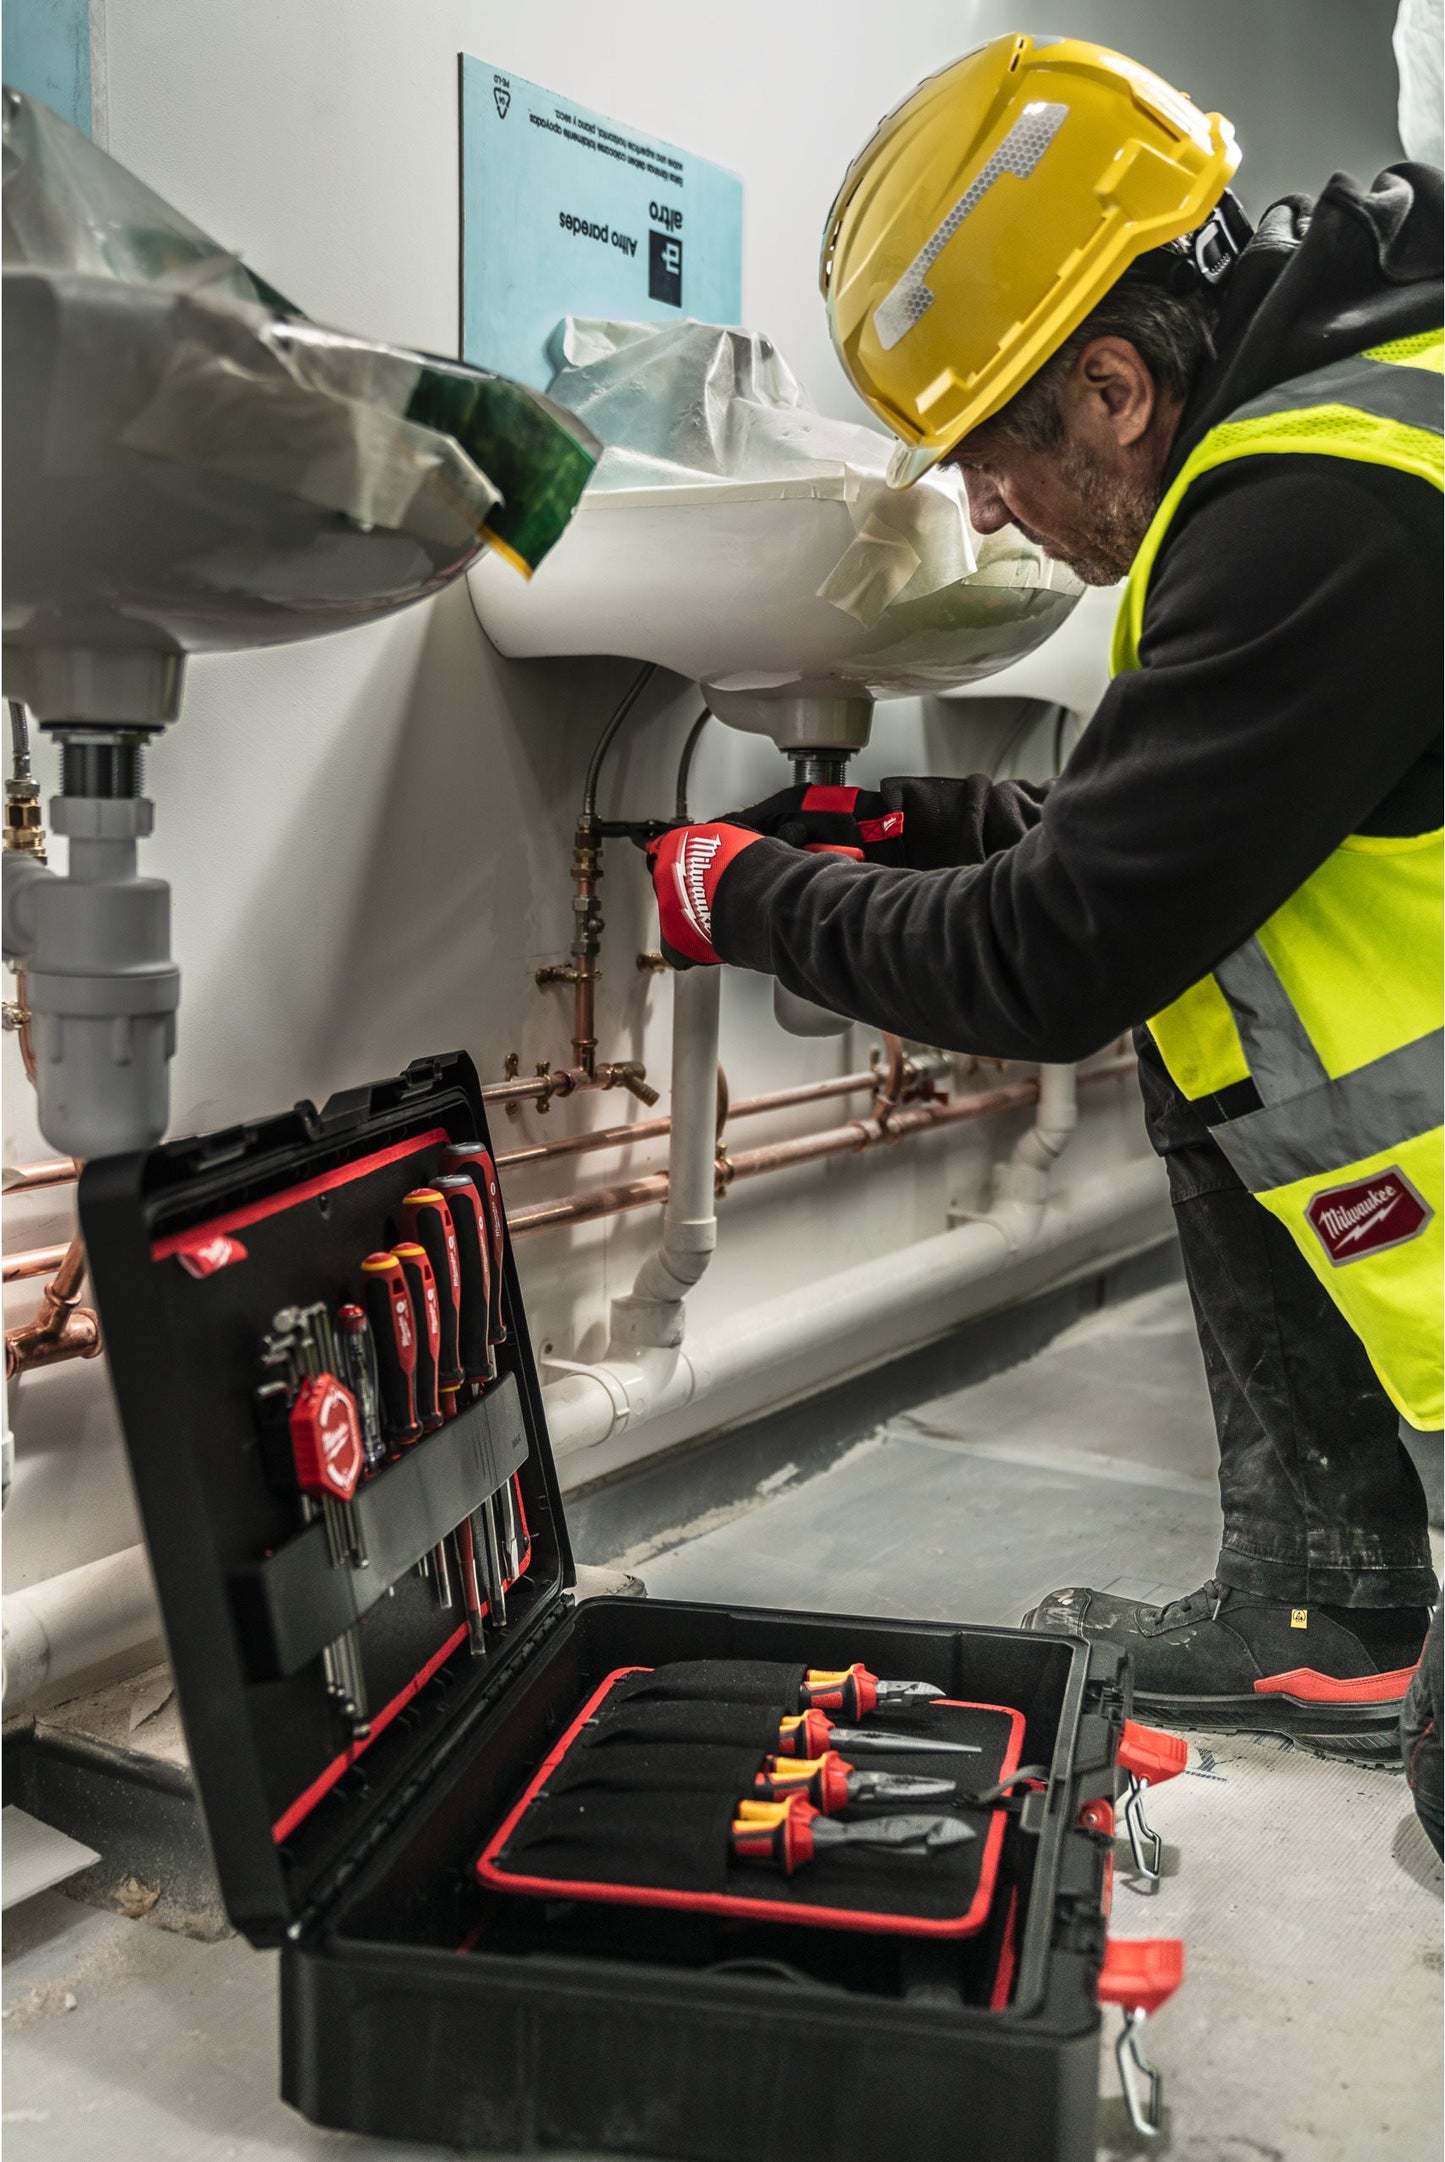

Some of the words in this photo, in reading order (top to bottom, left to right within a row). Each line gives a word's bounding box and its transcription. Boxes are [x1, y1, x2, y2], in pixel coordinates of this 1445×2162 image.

[573, 115, 577, 126] y
[563, 128, 596, 152] totalmente
[559, 211, 609, 244] paredes
[649, 200, 683, 232] altro
[611, 231, 638, 258] Altro
[688, 834, 721, 937] Milwauk
[1318, 1185, 1397, 1240] Milwaukee
